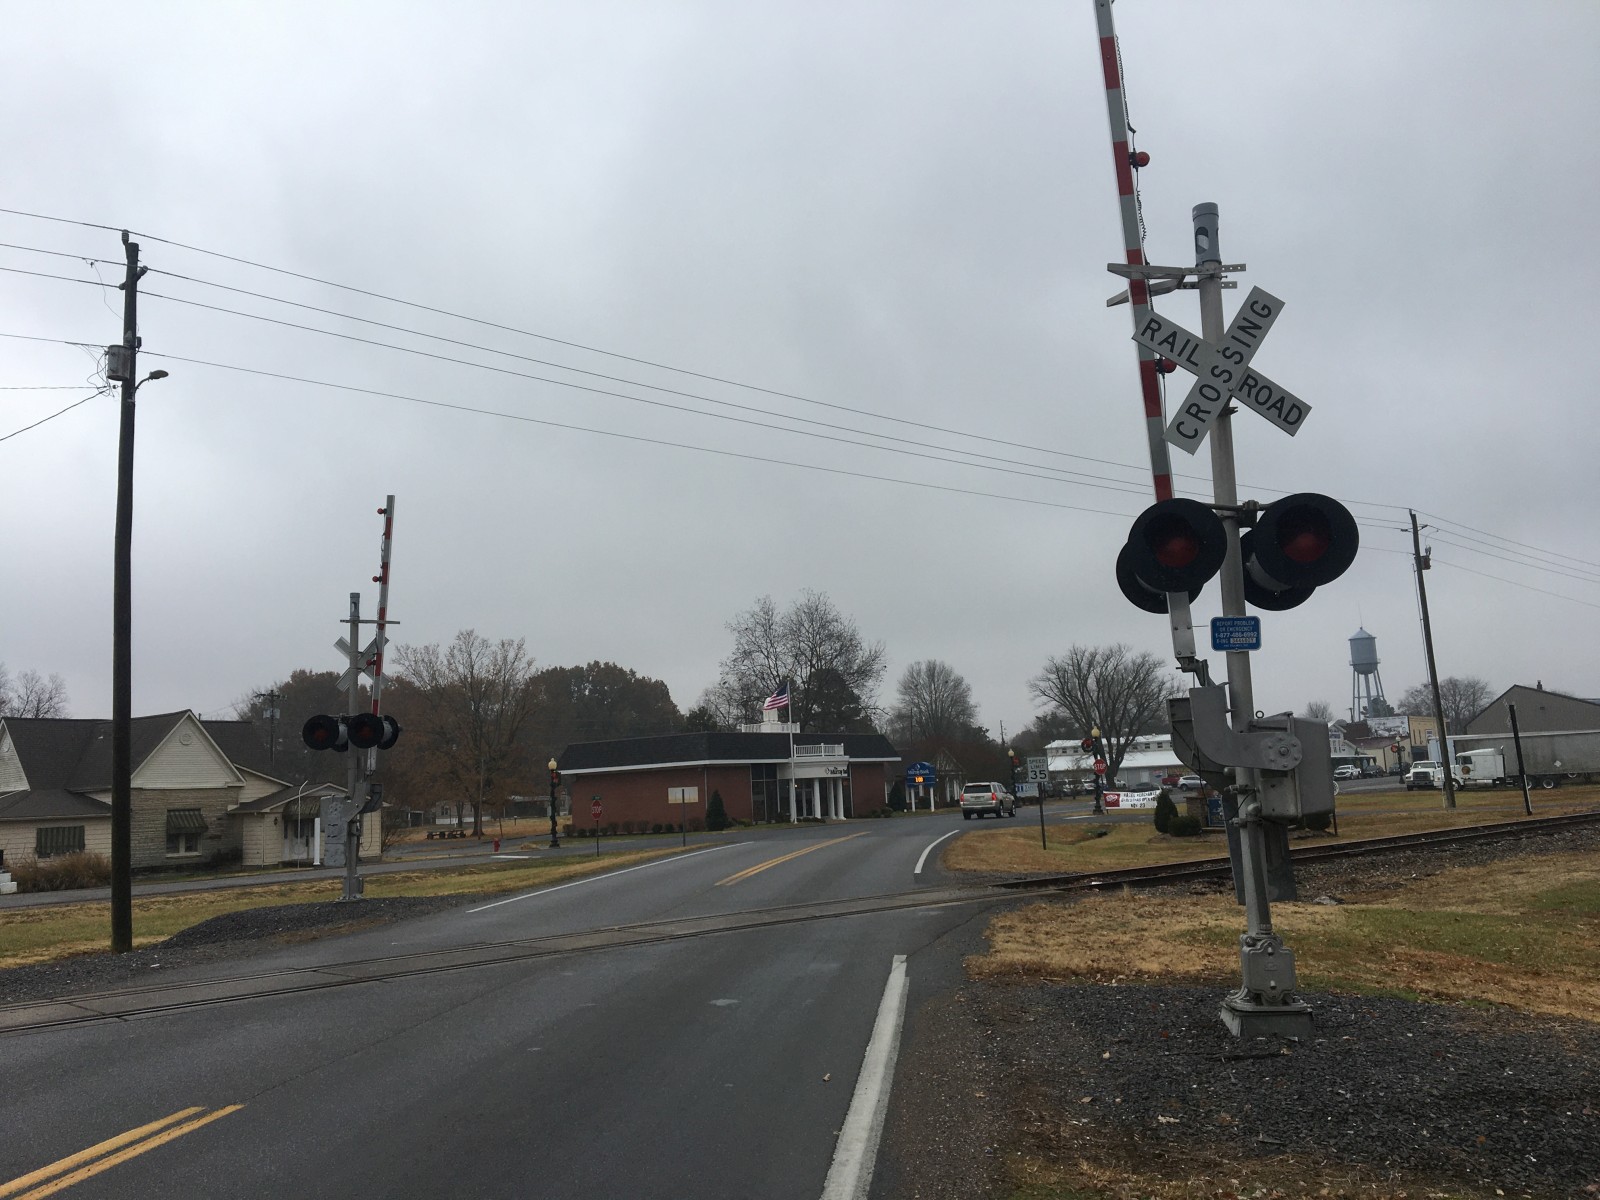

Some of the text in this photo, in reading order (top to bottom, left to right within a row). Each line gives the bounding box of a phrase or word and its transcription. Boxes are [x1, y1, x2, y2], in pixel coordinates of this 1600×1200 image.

[1140, 318, 1199, 367] RAIL
[1176, 298, 1272, 440] CROSSING
[1239, 373, 1303, 427] ROAD
[1031, 770, 1046, 779] 35
